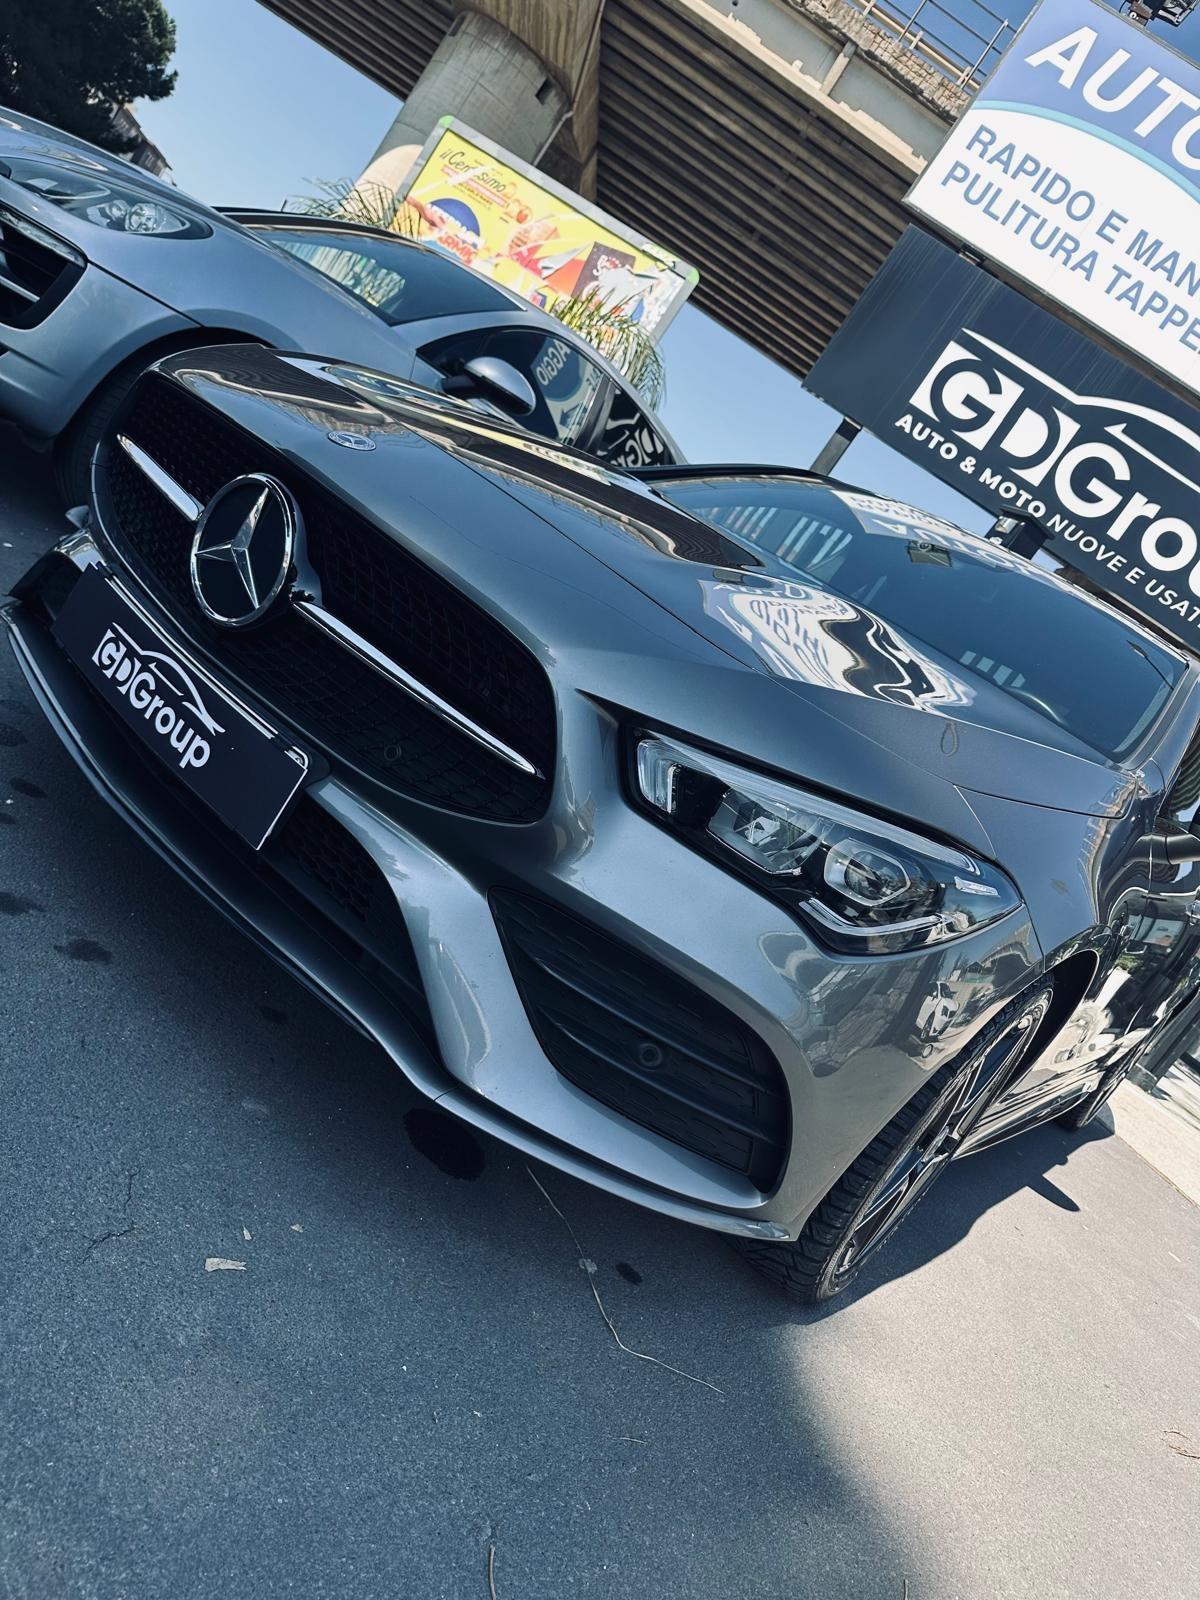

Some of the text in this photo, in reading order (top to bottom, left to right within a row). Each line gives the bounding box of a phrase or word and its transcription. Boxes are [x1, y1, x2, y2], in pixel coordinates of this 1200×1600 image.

[941, 160, 1200, 355] PULITURA TAPPE
[966, 124, 1095, 222] RAPIDO
[1096, 209, 1129, 245] E
[895, 414, 958, 459] AUTO
[960, 456, 977, 474] &
[979, 468, 1046, 518] MOTO
[1046, 513, 1128, 572] NUOVE
[1124, 567, 1146, 584] E
[1144, 579, 1200, 628] USAT
[909, 340, 1200, 597] GDGro
[91, 629, 211, 769] GDGroup
